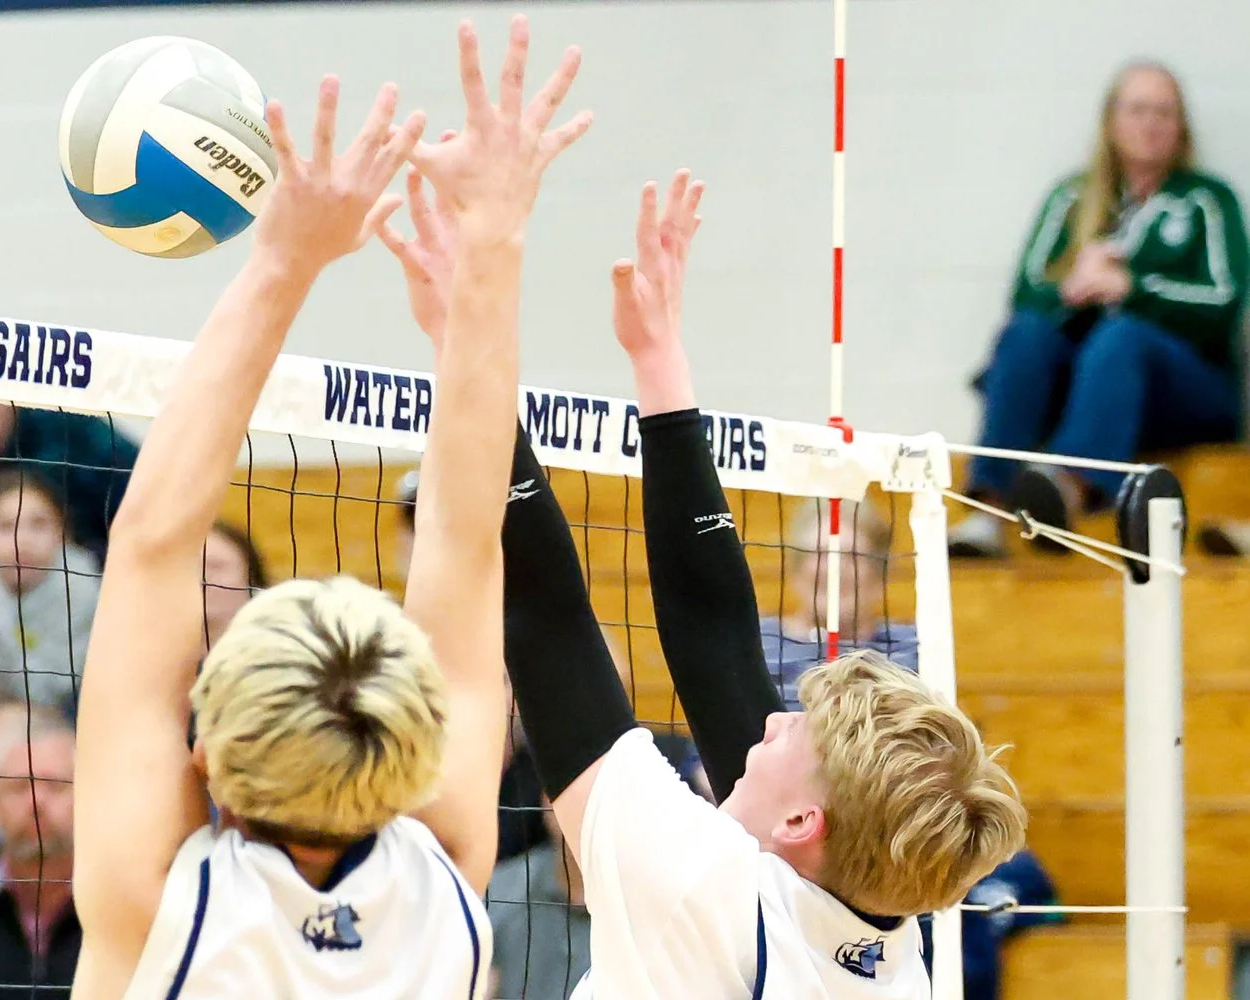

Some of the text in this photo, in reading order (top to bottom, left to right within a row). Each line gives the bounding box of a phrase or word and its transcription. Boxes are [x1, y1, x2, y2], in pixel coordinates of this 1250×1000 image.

[193, 136, 266, 198] Baden
[323, 364, 432, 434] WATER
[525, 391, 609, 453] MOTT
